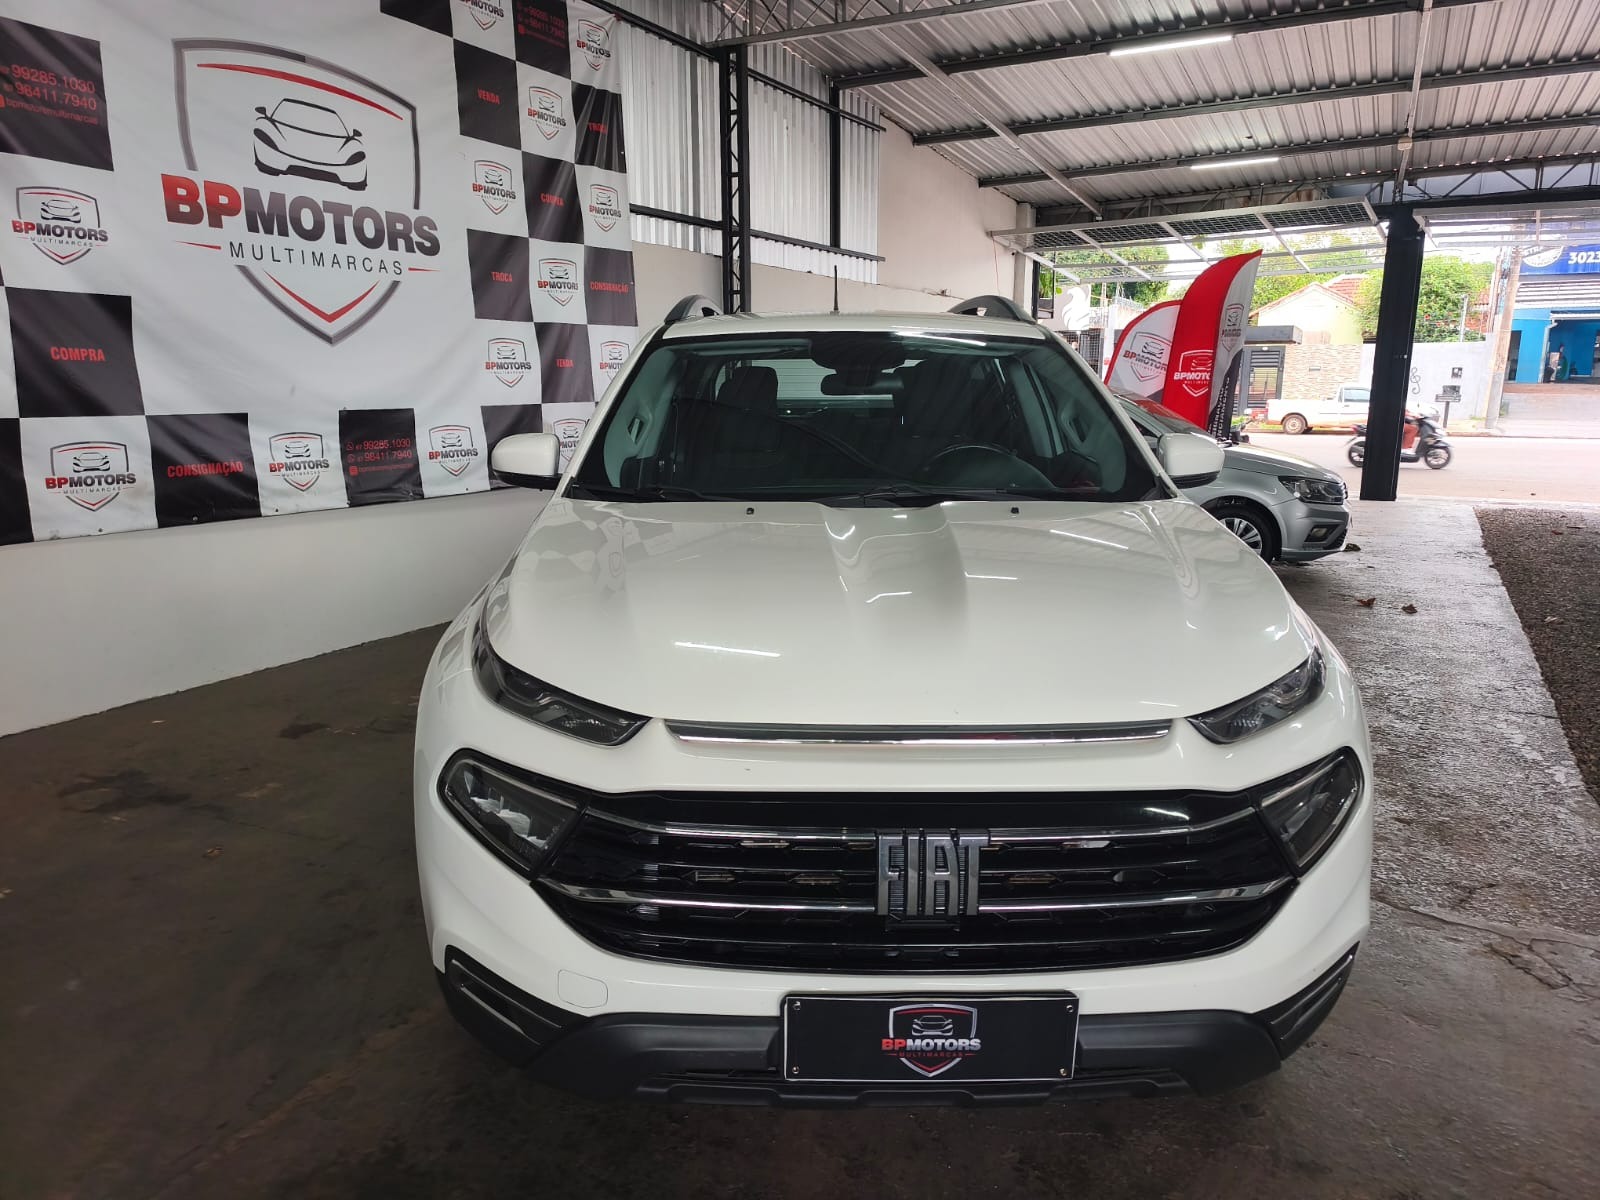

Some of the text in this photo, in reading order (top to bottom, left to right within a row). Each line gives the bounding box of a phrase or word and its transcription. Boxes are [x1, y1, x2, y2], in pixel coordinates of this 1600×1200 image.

[461, 0, 504, 17] MOTORS
[11, 64, 96, 94] 99285.1030
[477, 88, 500, 104] VENDA
[528, 108, 567, 127] BPMOTORS
[472, 183, 516, 199] BPMOTORS
[161, 173, 440, 256] BPMOTORS
[589, 205, 622, 218] BPMOTORS
[12, 219, 108, 242] BPMOTORS
[230, 241, 403, 275] MULTIMARCAS
[491, 271, 513, 282] TROCA
[537, 280, 579, 290] BPMOTORS
[50, 347, 105, 362] COMPRA
[485, 361, 532, 370] BPMOTORS
[428, 448, 479, 460] BPMOTORS
[167, 460, 243, 478] CONSIGNAÇÃO
[269, 459, 330, 473] BPMOTORS
[45, 473, 136, 489] BPMOTORS
[877, 834, 989, 916] FIAT
[881, 1038, 981, 1051] BPMOTORS
